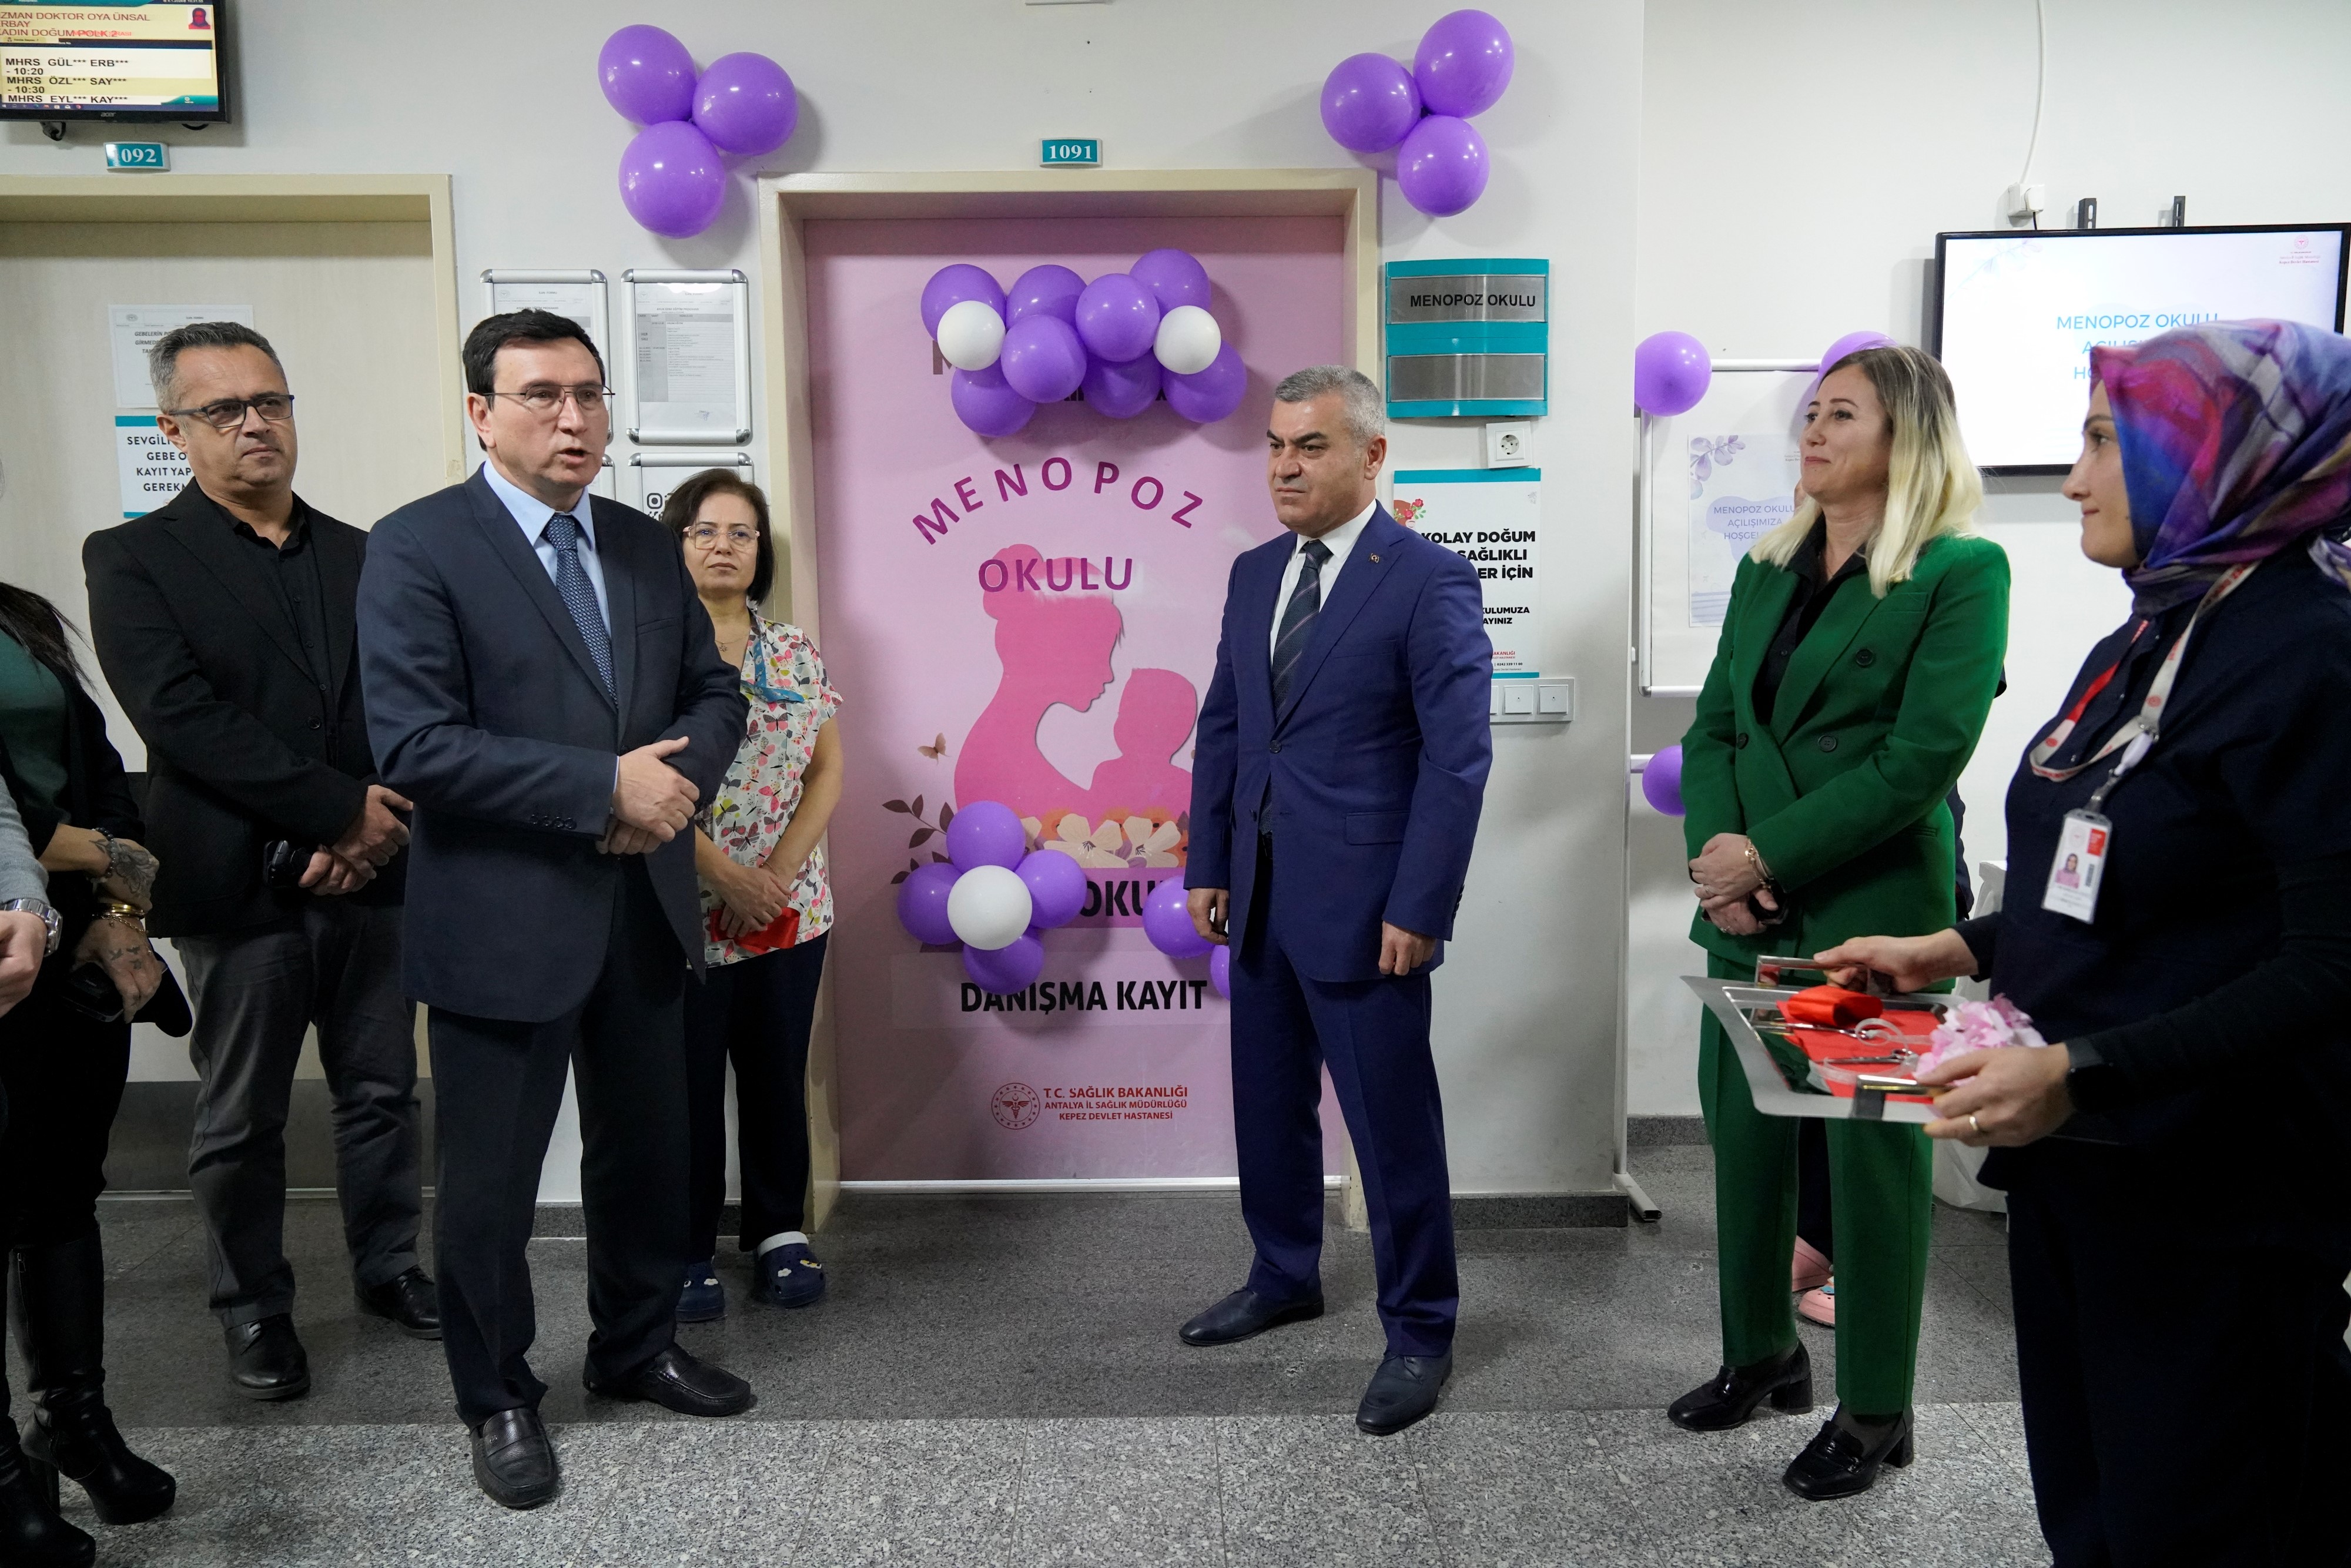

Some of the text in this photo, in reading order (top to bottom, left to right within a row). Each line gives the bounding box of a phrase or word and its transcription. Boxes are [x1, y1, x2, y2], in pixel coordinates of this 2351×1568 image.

[113, 12, 150, 21] ÜNSAL
[32, 28, 75, 36] DOĞUM
[1049, 145, 1093, 159] 1091
[1411, 294, 1536, 307] MENOPOZ OKULU
[2057, 314, 2150, 329] MENOPOZ
[146, 452, 175, 460] GEBE
[136, 467, 192, 475] KAYIT YAP
[912, 457, 1203, 545] MENOPOZ
[1714, 505, 1795, 514] MENOPOZ OKULU
[1727, 518, 1782, 528] AÇILIŞIMIZA
[1421, 528, 1536, 544] KOLAY DOĞUM
[1456, 547, 1527, 561] SAĞLIKLI
[978, 556, 1133, 592] OKULU
[1502, 565, 1533, 581] İÇİN
[960, 980, 1208, 1016] DANIŞMA KAYIT
[1069, 1085, 1115, 1098] SAĞLIK
[1118, 1084, 1188, 1098] BAKANLIĞI
[1086, 1101, 1094, 1109] İL
[1096, 1100, 1127, 1109] SAĞLIK
[1129, 1099, 1187, 1108] MÜDÜRLÜĞÜ
[1089, 1112, 1122, 1120] DEVLET
[1124, 1110, 1173, 1120] HASTANESİ
